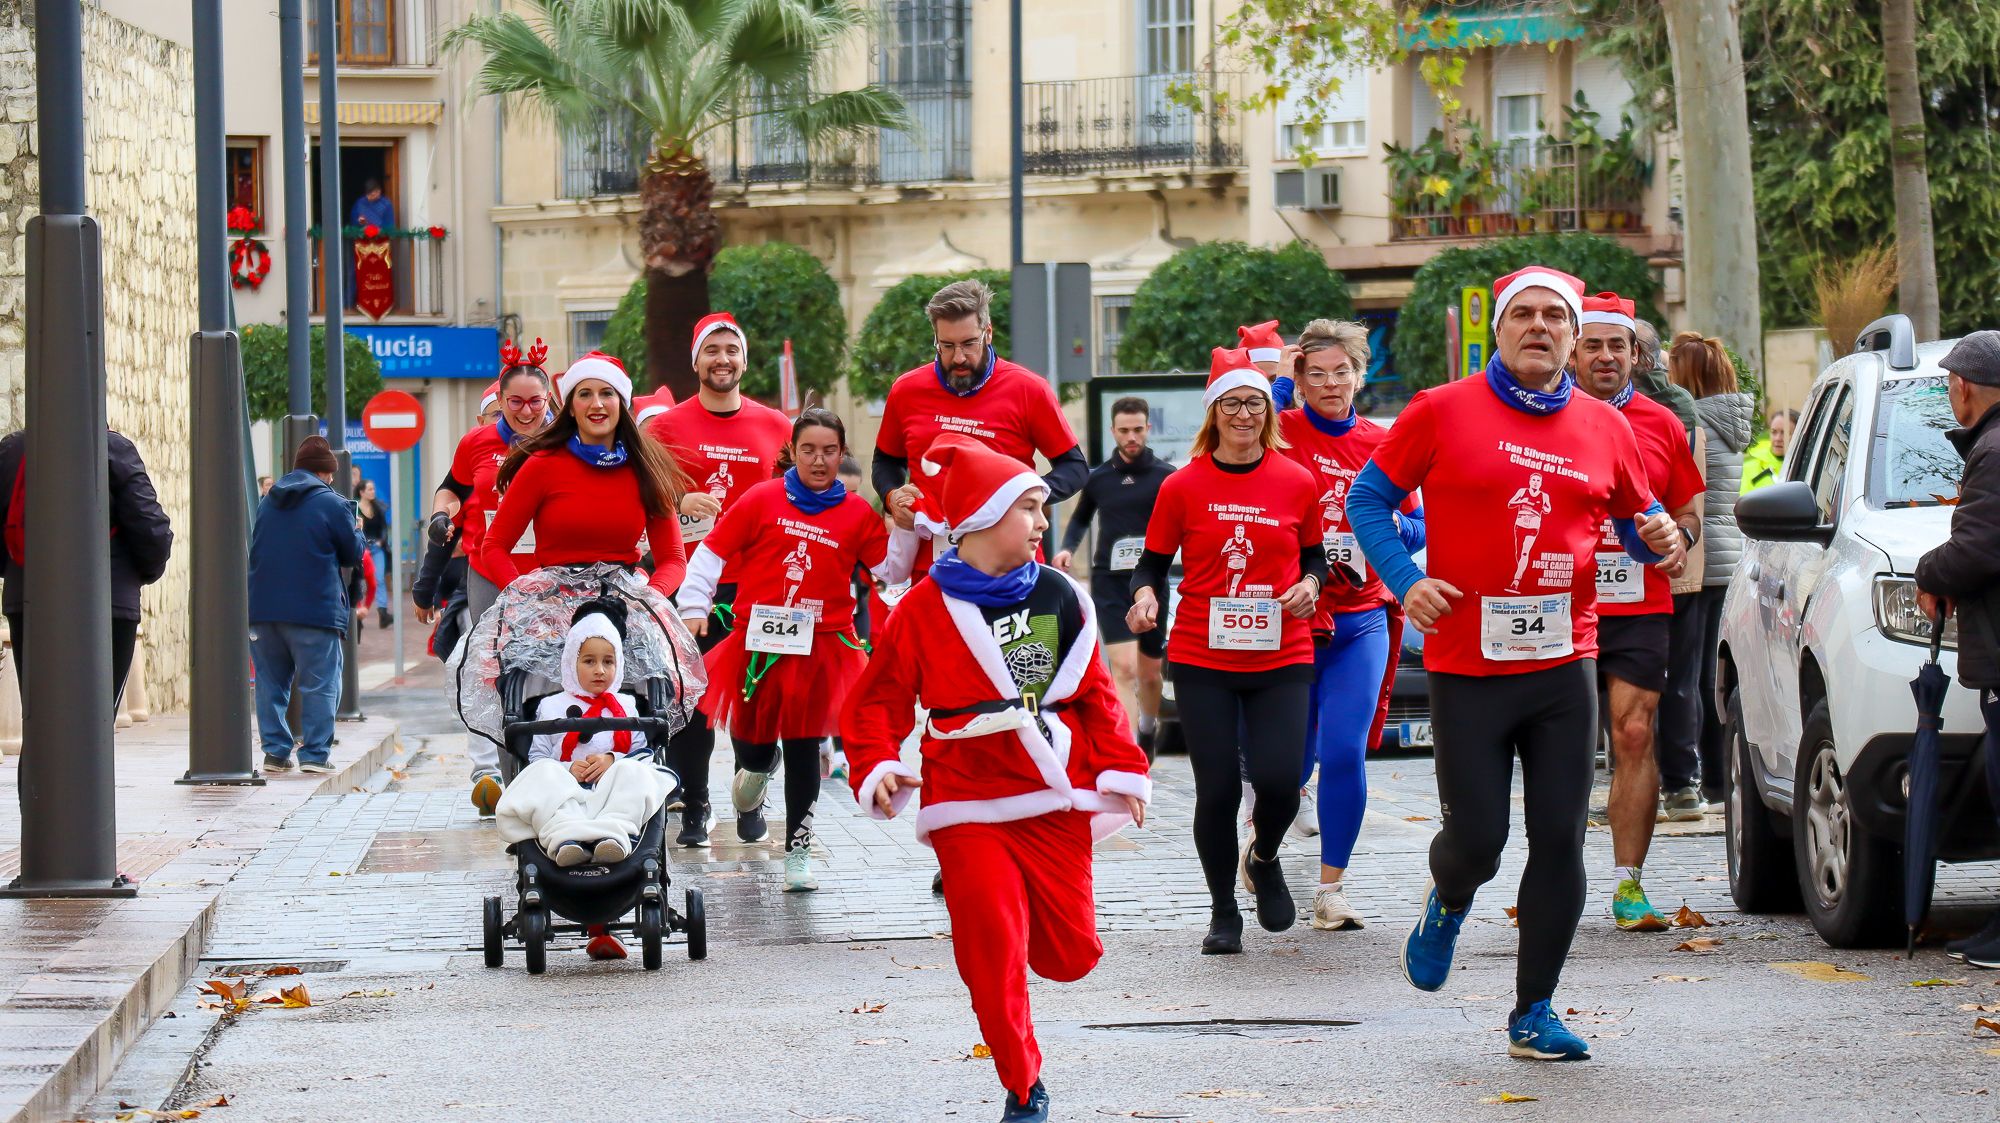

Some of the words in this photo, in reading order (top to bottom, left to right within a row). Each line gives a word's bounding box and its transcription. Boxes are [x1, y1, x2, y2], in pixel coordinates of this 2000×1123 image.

[939, 415, 951, 423] San
[951, 416, 978, 427] Silvestre
[941, 423, 963, 432] Ciudad
[963, 425, 972, 434] de
[972, 427, 995, 439] Lucena
[706, 451, 729, 460] Ciudad
[737, 455, 760, 464] Lucena
[715, 446, 743, 455] Silvestre
[1498, 441, 1504, 450] I
[1505, 442, 1522, 455] San
[1523, 446, 1564, 465] Silvestre
[1317, 455, 1331, 466] San
[1510, 453, 1542, 470] Ciudad
[1543, 462, 1555, 473] de
[1557, 465, 1589, 482] Lucena
[1213, 503, 1227, 512] San
[1228, 504, 1260, 515] Silvestre
[781, 518, 795, 527] San
[795, 521, 824, 535] Silvestre
[1218, 512, 1243, 522] Ciudad
[1244, 513, 1254, 523] de
[1254, 515, 1280, 527] Lucena
[784, 526, 808, 539] Ciudad
[808, 532, 817, 541] de
[817, 535, 839, 549] Lucena
[1119, 548, 1142, 558] 378
[1541, 552, 1574, 561] MEMORIAL
[1550, 561, 1574, 571] CARLOS
[1543, 569, 1574, 579] HURTADO
[762, 620, 799, 637] 614
[1223, 614, 1269, 630] 505
[1511, 616, 1545, 636] 34
